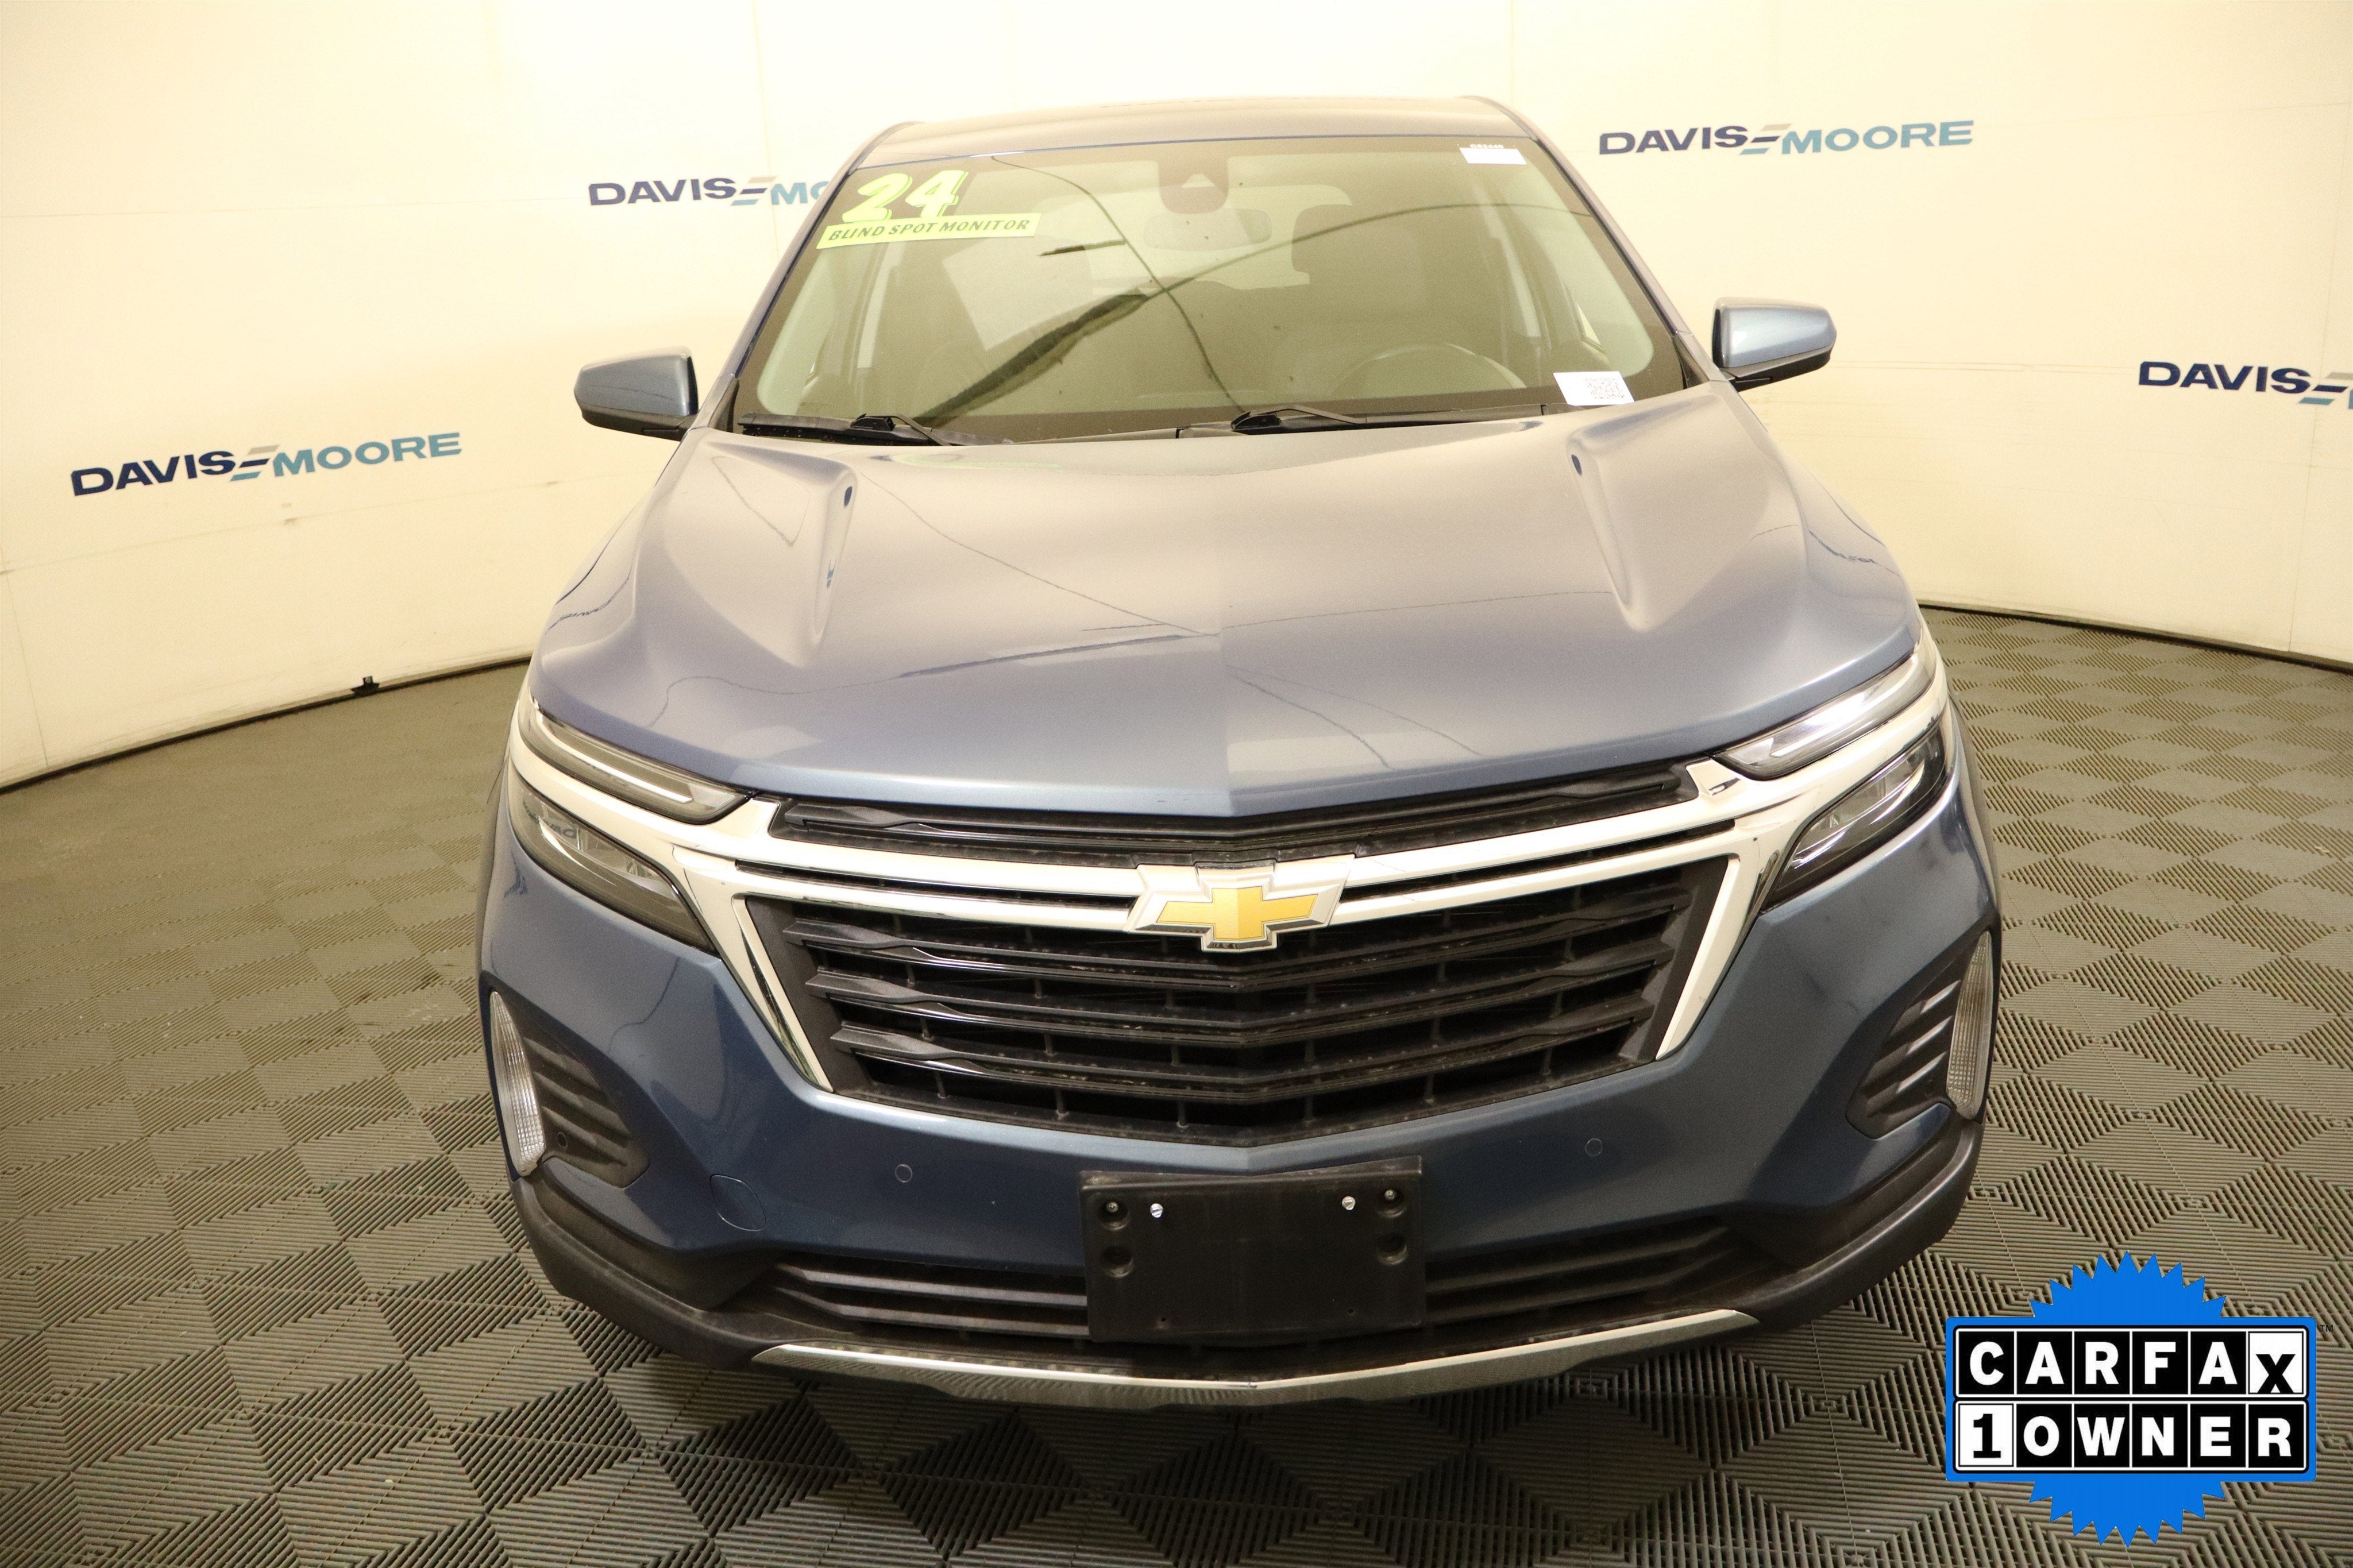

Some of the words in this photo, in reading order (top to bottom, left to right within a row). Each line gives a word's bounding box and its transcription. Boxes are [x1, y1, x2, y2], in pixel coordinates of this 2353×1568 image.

[1599, 125, 1748, 155] DAVIS
[1781, 121, 1973, 155] MOORE
[588, 177, 736, 206] DAVIS
[842, 170, 969, 223] 24
[828, 226, 885, 240] BLIND
[888, 222, 938, 234] SPOT
[939, 220, 1030, 232] MONITOR
[2138, 361, 2310, 394] DAVIS
[70, 450, 236, 496] DAVIS
[272, 432, 461, 477] MOORE
